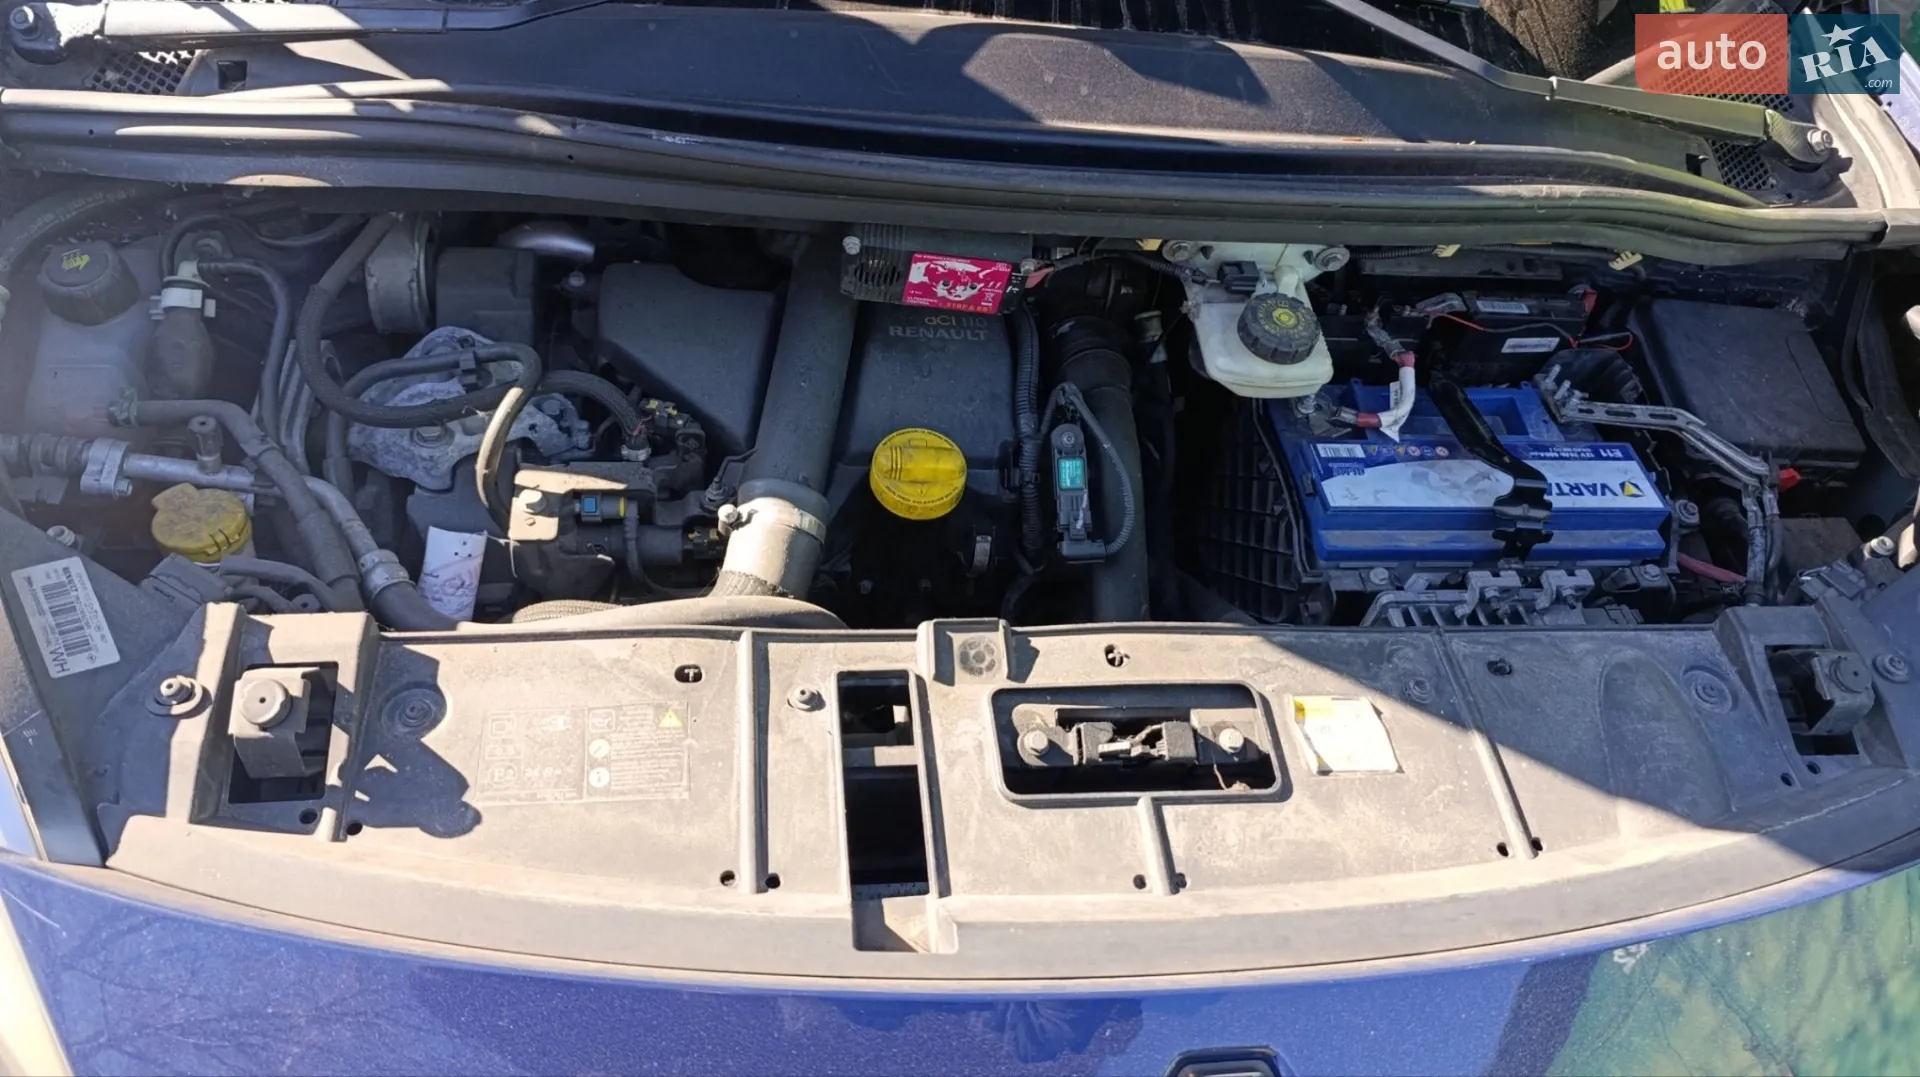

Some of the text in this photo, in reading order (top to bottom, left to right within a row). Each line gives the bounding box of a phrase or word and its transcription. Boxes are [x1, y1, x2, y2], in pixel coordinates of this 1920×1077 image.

[962, 316, 988, 328] 110
[888, 325, 989, 341] RENAULT
[1598, 447, 1624, 458] E11
[49, 646, 71, 674] WH
